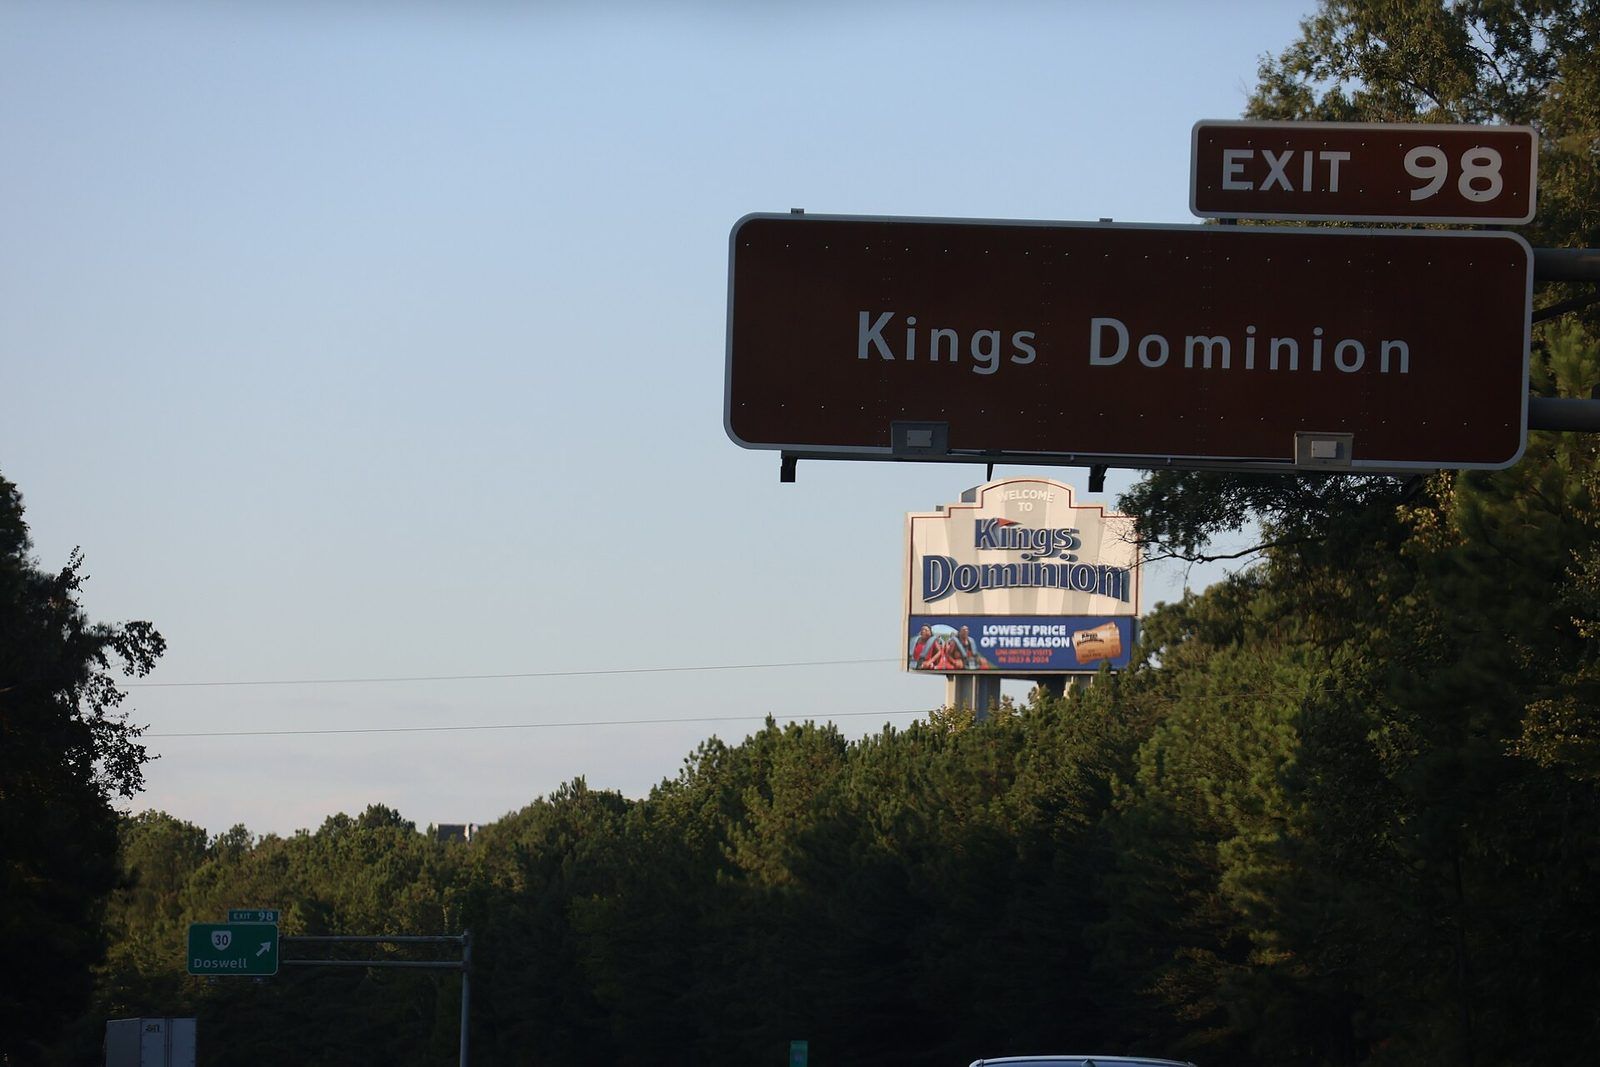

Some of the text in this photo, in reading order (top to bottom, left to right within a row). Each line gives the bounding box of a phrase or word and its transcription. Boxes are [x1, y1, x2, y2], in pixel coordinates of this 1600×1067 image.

[1222, 145, 1503, 203] EXIT 98
[857, 311, 1410, 375] Kings Dominion
[1000, 489, 1054, 502] WELCOME
[1018, 502, 1032, 511] TO
[975, 517, 1077, 556] Kings
[922, 553, 1130, 602] Dominion
[983, 625, 1066, 636] LOWEST PRICE
[980, 637, 997, 648] OF
[998, 637, 1022, 648] THE
[1023, 637, 1070, 648] SEASON
[233, 911, 274, 921] EXIT 98
[215, 934, 229, 946] 30
[193, 958, 247, 969] Doswell
